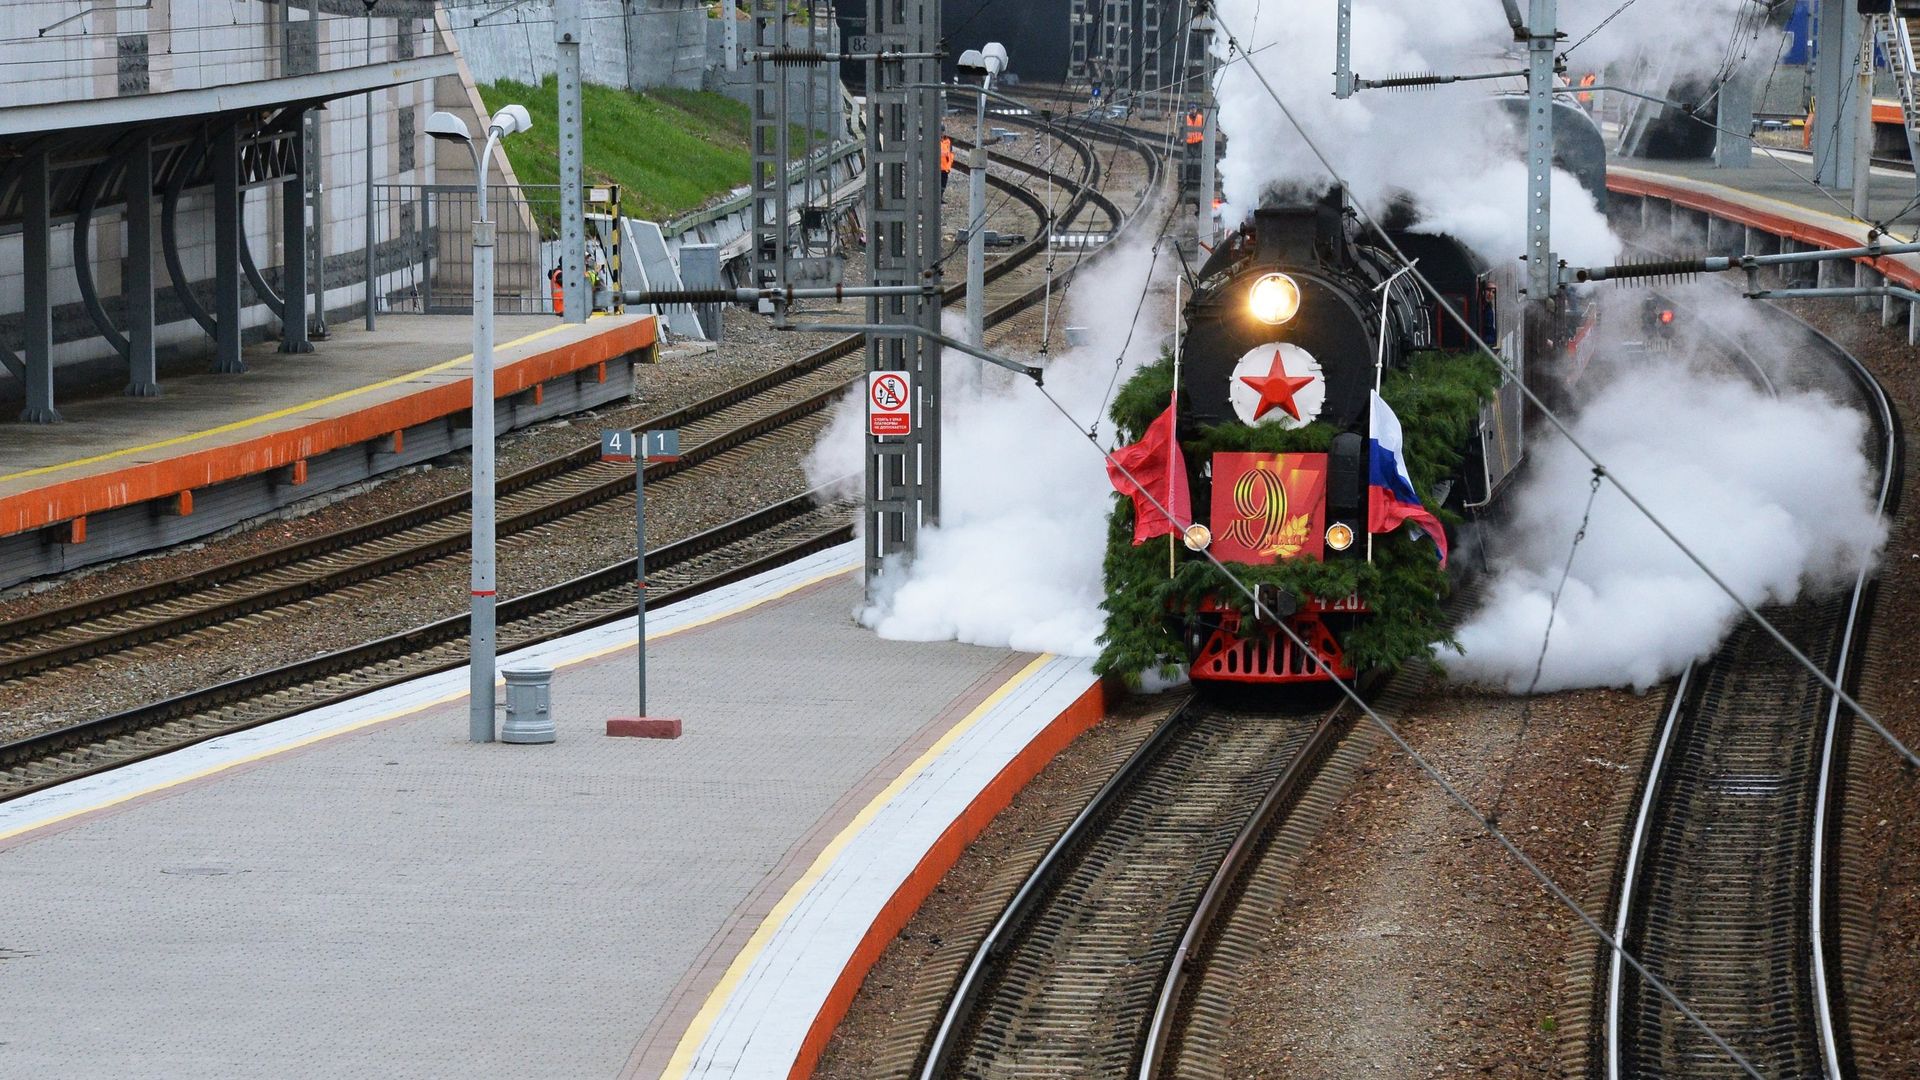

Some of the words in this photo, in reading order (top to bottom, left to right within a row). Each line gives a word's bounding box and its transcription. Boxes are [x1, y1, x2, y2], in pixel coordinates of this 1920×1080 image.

[609, 432, 622, 451] 4
[657, 432, 664, 451] 1
[1219, 468, 1288, 550] 9
